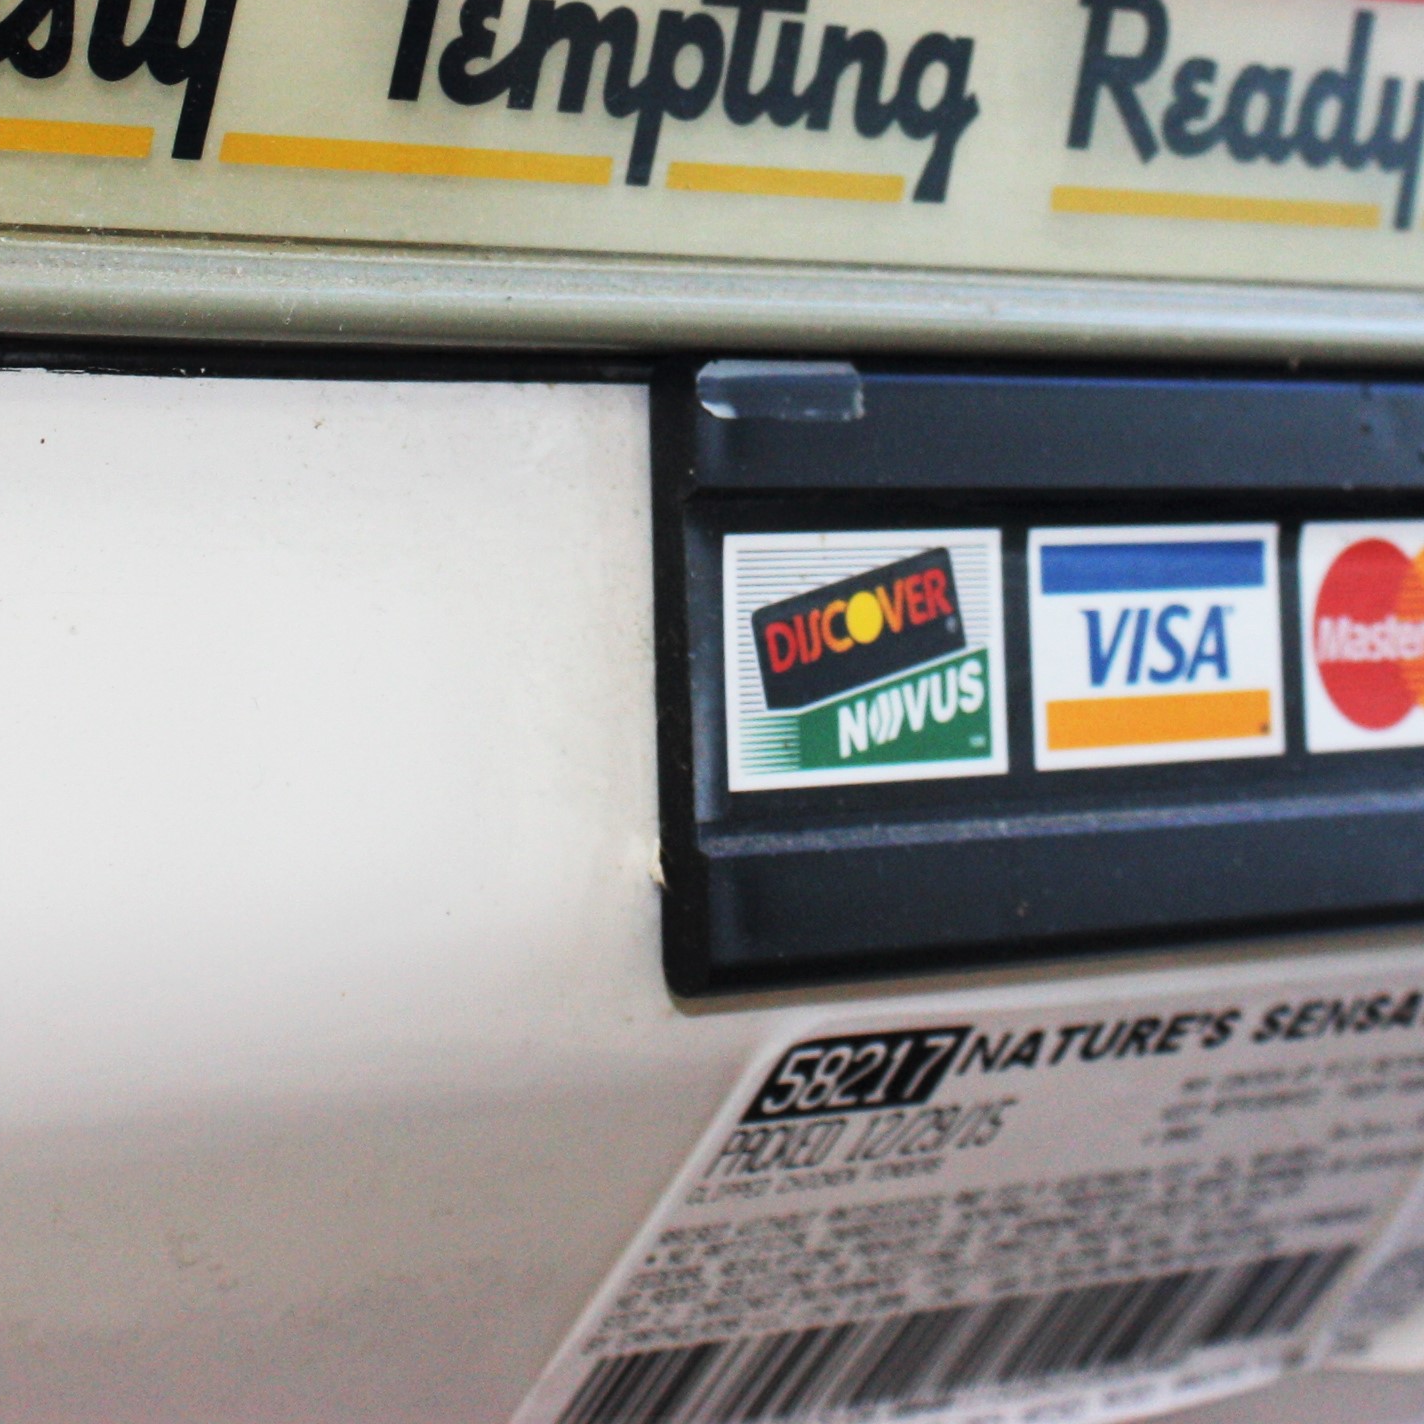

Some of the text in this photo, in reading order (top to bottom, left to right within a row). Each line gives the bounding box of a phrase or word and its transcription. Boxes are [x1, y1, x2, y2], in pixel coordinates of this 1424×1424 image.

[764, 567, 954, 674] DISCOVER
[1081, 604, 1232, 687] VISA
[837, 659, 985, 760] NOVUS
[761, 1034, 957, 1115] 58217
[955, 1008, 1242, 1076] NATURE'S
